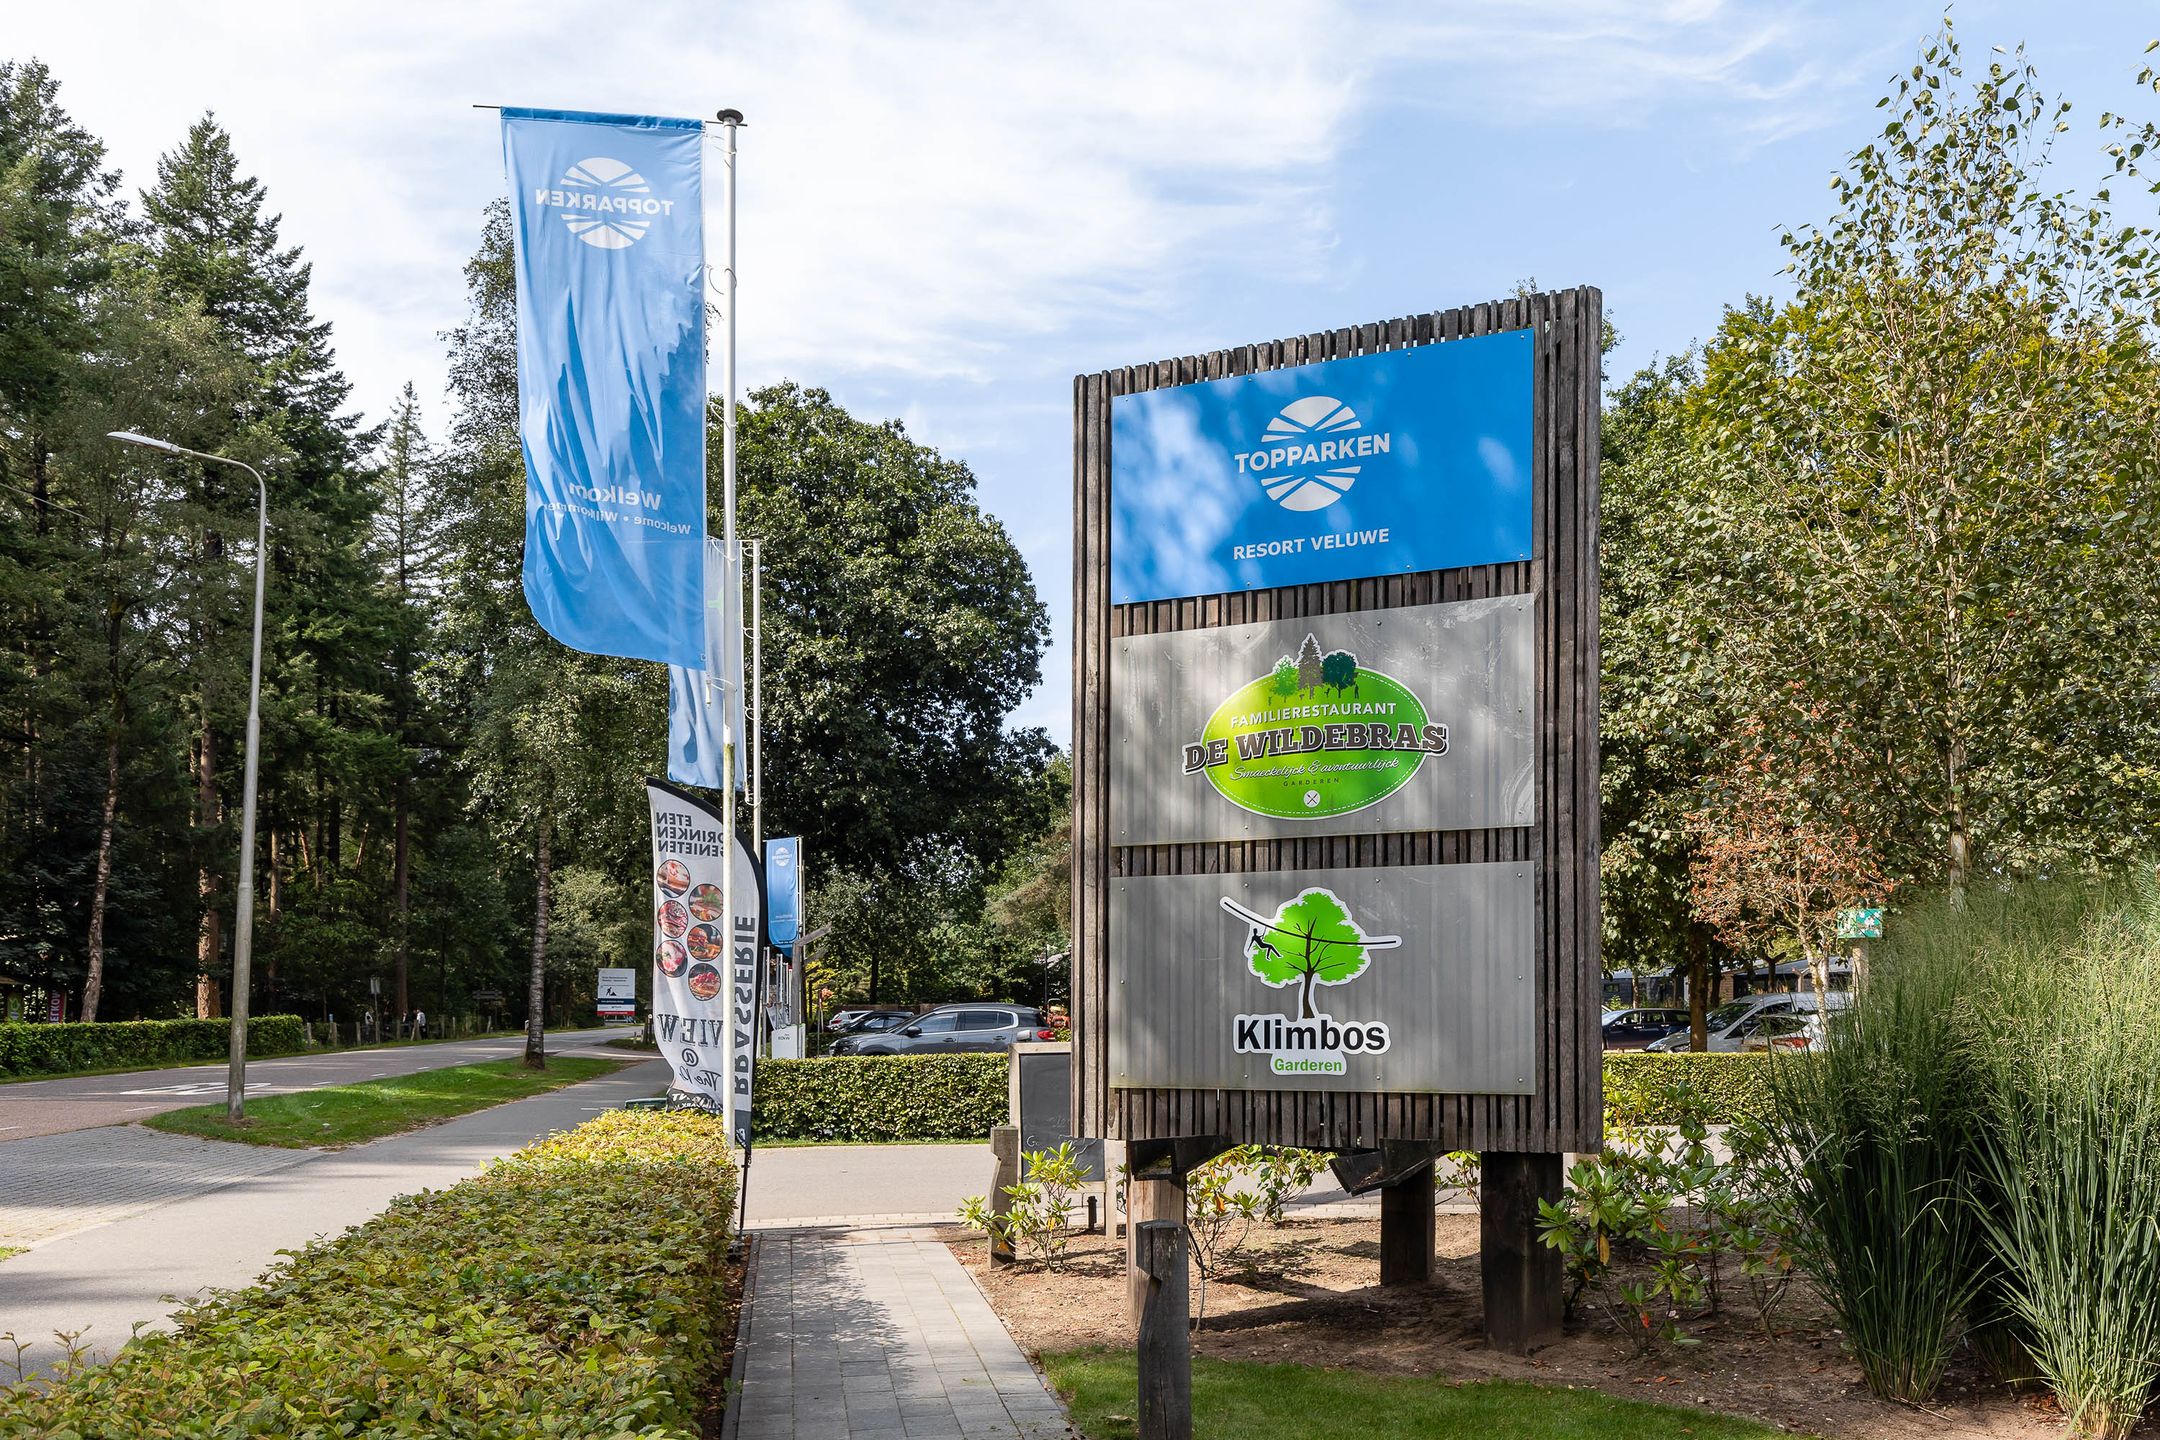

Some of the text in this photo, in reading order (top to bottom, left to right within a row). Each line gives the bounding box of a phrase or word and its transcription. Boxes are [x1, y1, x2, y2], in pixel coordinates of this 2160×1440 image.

[1234, 432, 1391, 474] TOPPARKEN
[1233, 528, 1390, 560] RESORT VELUWE
[1231, 703, 1397, 728] FAMILIERESTAURANT
[1184, 722, 1447, 774] DE WILDEBRAS
[1307, 759, 1321, 775] &
[1321, 757, 1400, 773] avontuurlijck
[1283, 777, 1340, 787] GARDEREN
[1237, 1019, 1385, 1051] Klimbos
[1274, 1058, 1342, 1071] Garderen
